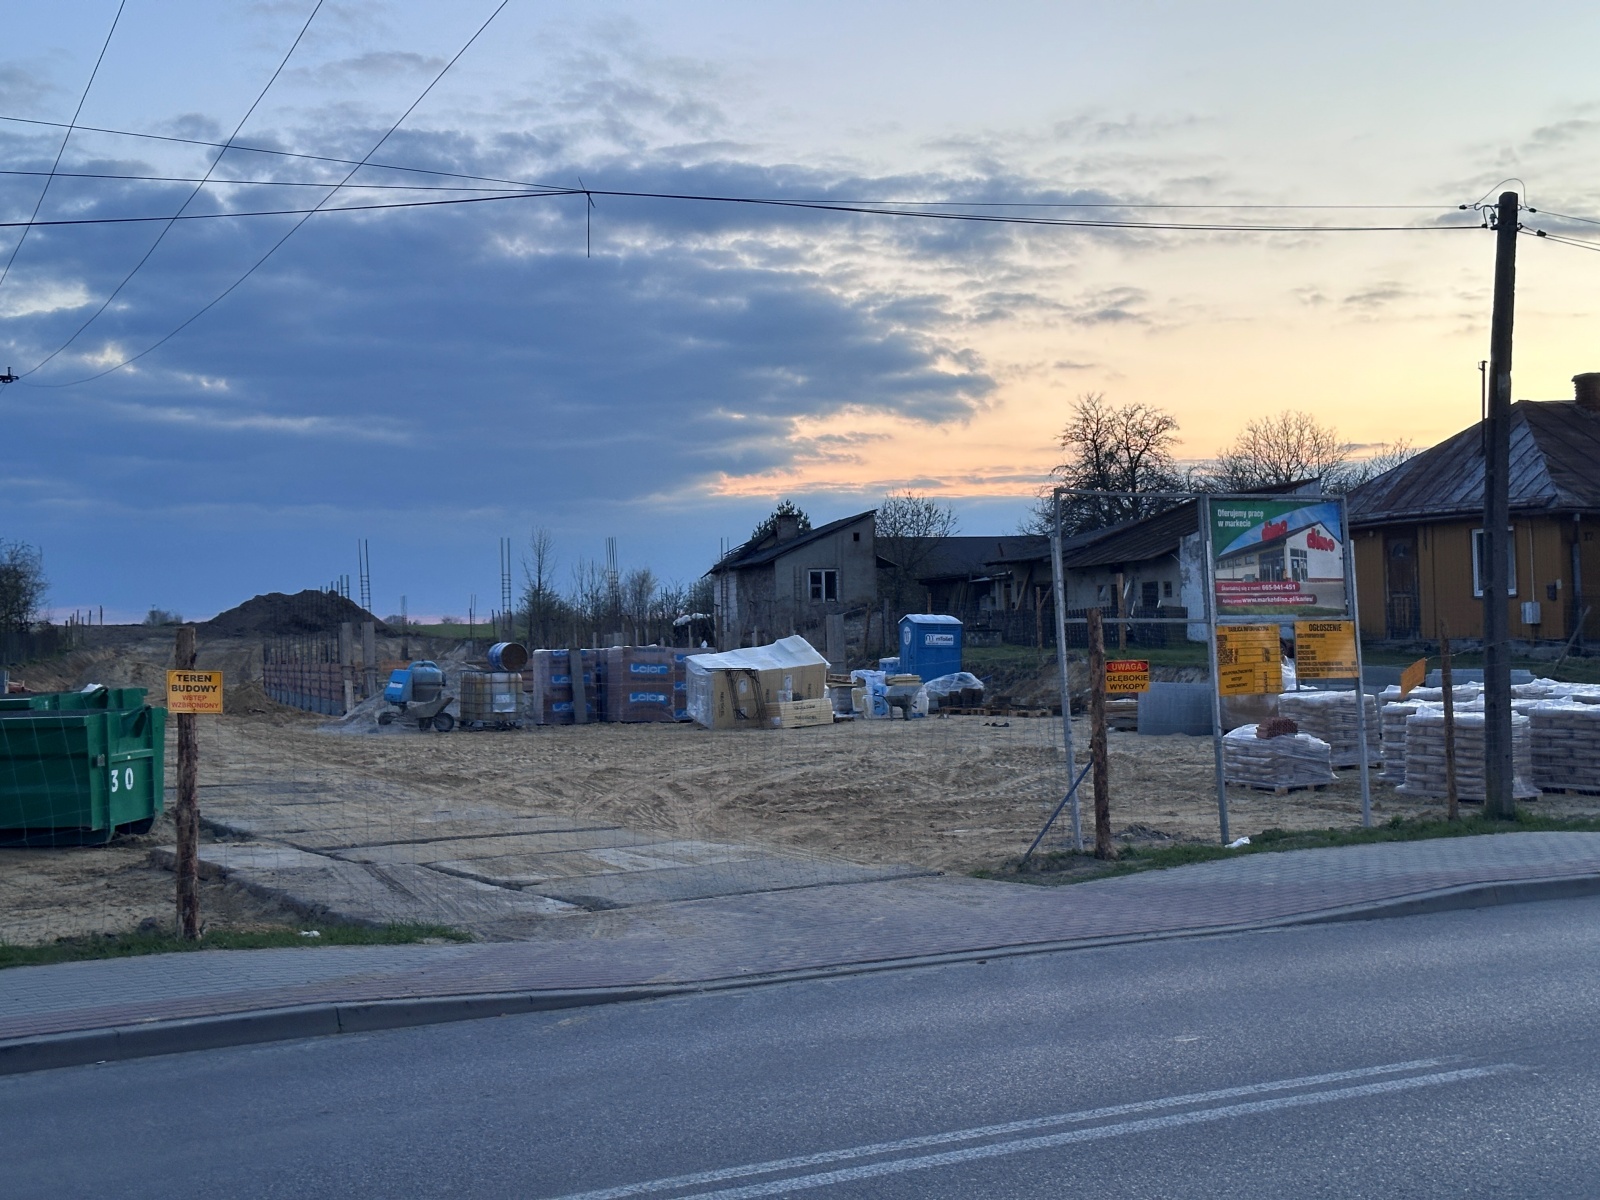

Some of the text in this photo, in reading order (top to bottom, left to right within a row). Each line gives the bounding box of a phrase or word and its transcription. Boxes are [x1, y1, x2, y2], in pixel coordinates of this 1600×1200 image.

[1217, 509, 1264, 519] Oferujemy pracę
[1225, 519, 1251, 527] markecie
[1307, 528, 1335, 552] dino
[1308, 623, 1342, 632] OGŁOSZENIE
[1107, 675, 1148, 683] GŁĘBOKIE
